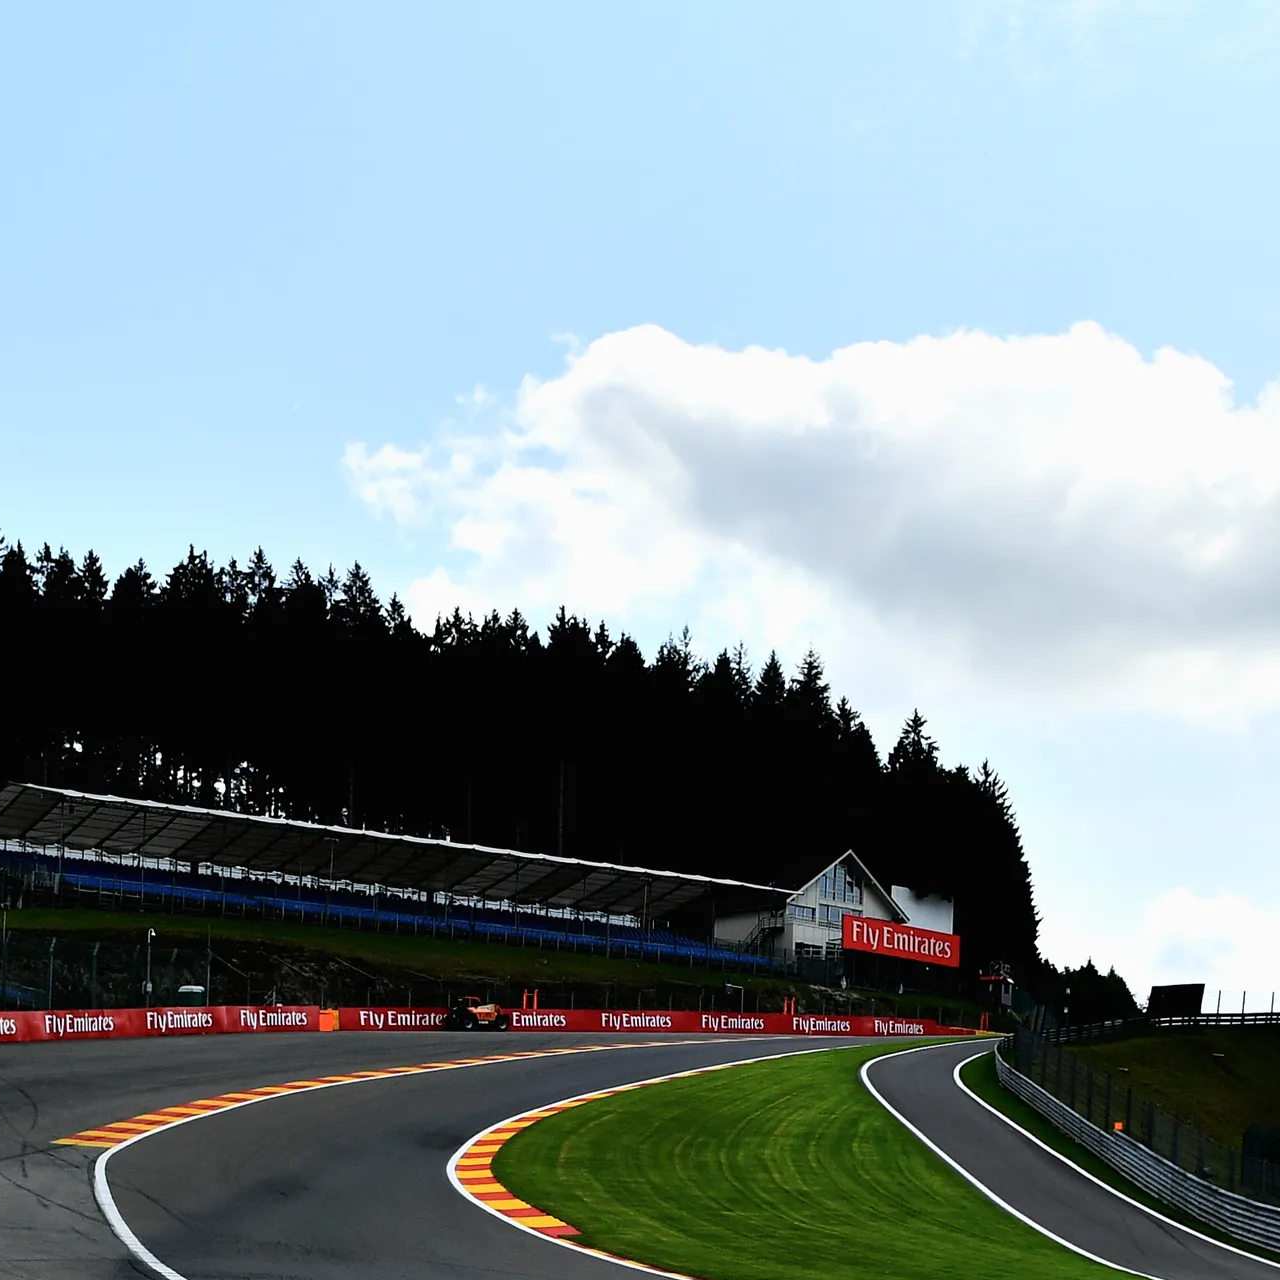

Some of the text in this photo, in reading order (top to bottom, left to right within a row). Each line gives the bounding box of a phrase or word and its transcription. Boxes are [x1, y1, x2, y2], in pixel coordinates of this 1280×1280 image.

[852, 920, 952, 958] Fly Emirates
[44, 1012, 114, 1037] Fly Emirates
[146, 1010, 213, 1033] Fly Emirates
[240, 1009, 308, 1030] Fly Emirates
[359, 1010, 385, 1029] Fly
[512, 1011, 567, 1027] Emirates
[601, 1012, 672, 1031] Fly Emirates
[701, 1014, 765, 1032] Fly Emirates
[792, 1017, 851, 1034] Fly Emirates
[874, 1019, 924, 1036] Fly Emirates
